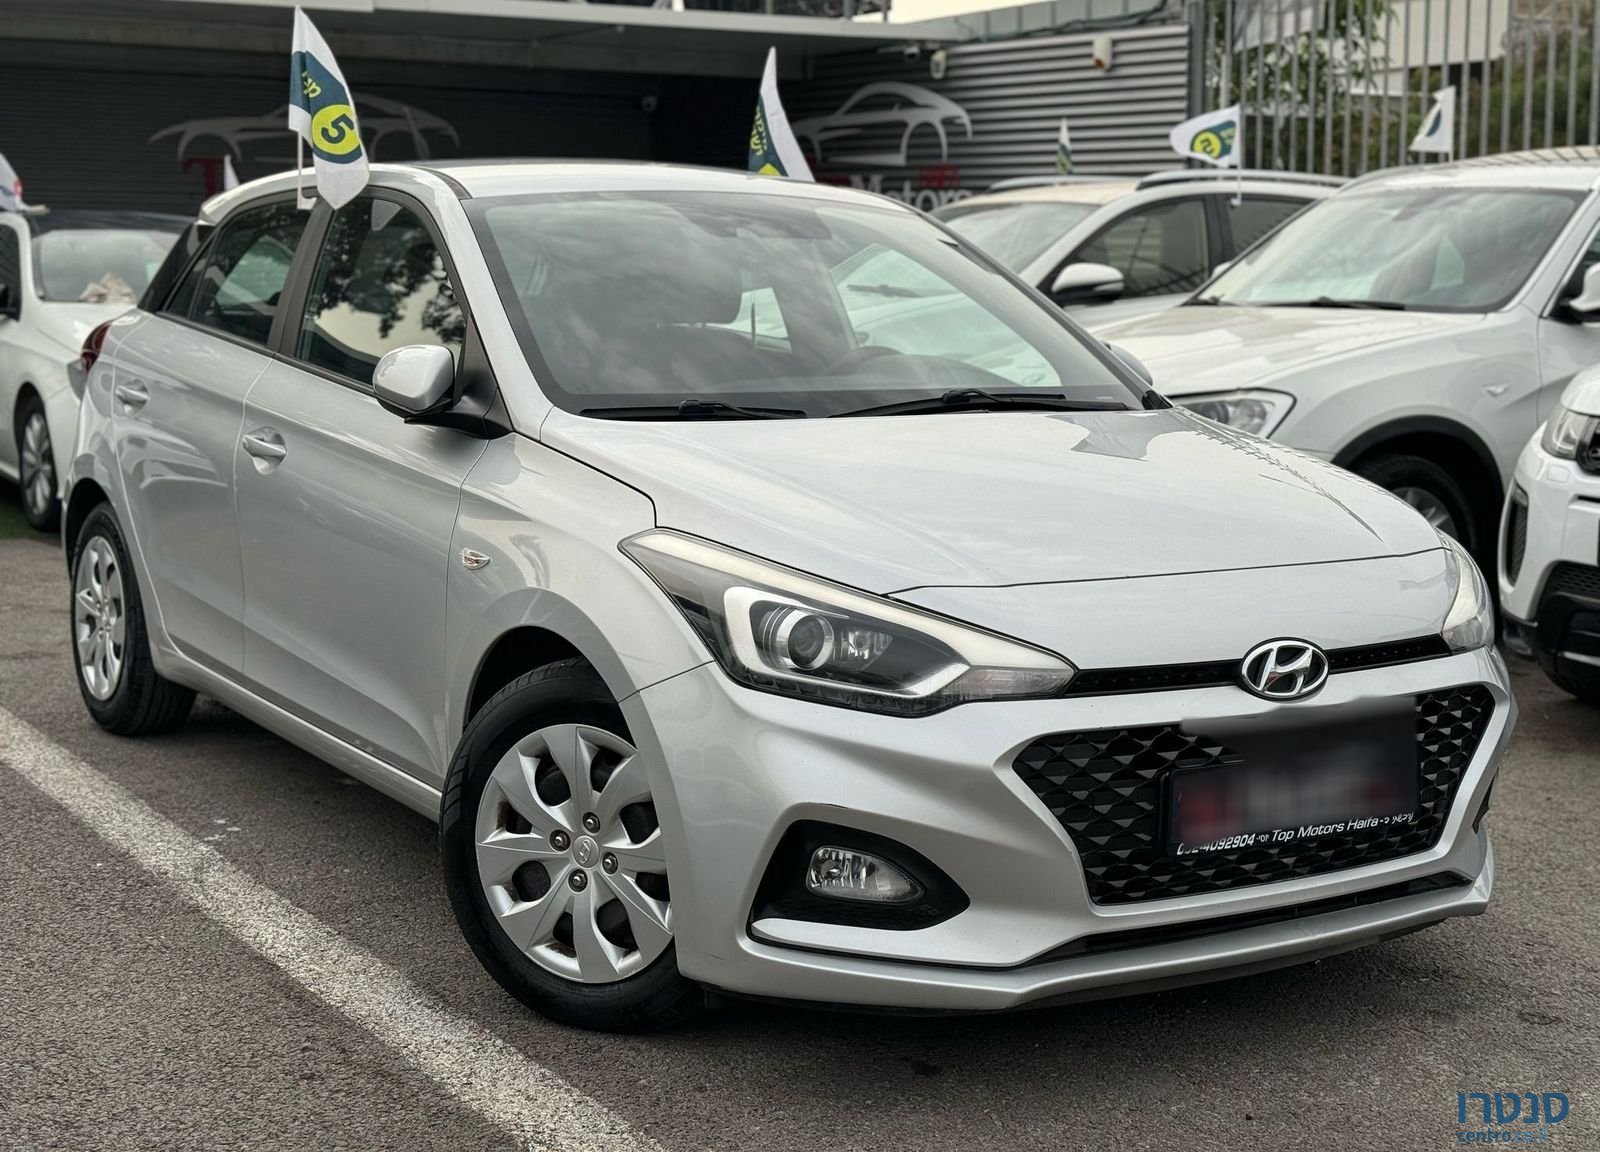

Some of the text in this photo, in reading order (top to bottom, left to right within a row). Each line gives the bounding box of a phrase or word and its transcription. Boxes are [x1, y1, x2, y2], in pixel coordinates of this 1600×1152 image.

[321, 113, 355, 144] 5
[849, 173, 973, 213] Mtor
[1272, 829, 1295, 842] Top
[1297, 822, 1345, 838] Motors
[1347, 817, 1379, 831] Haifa
